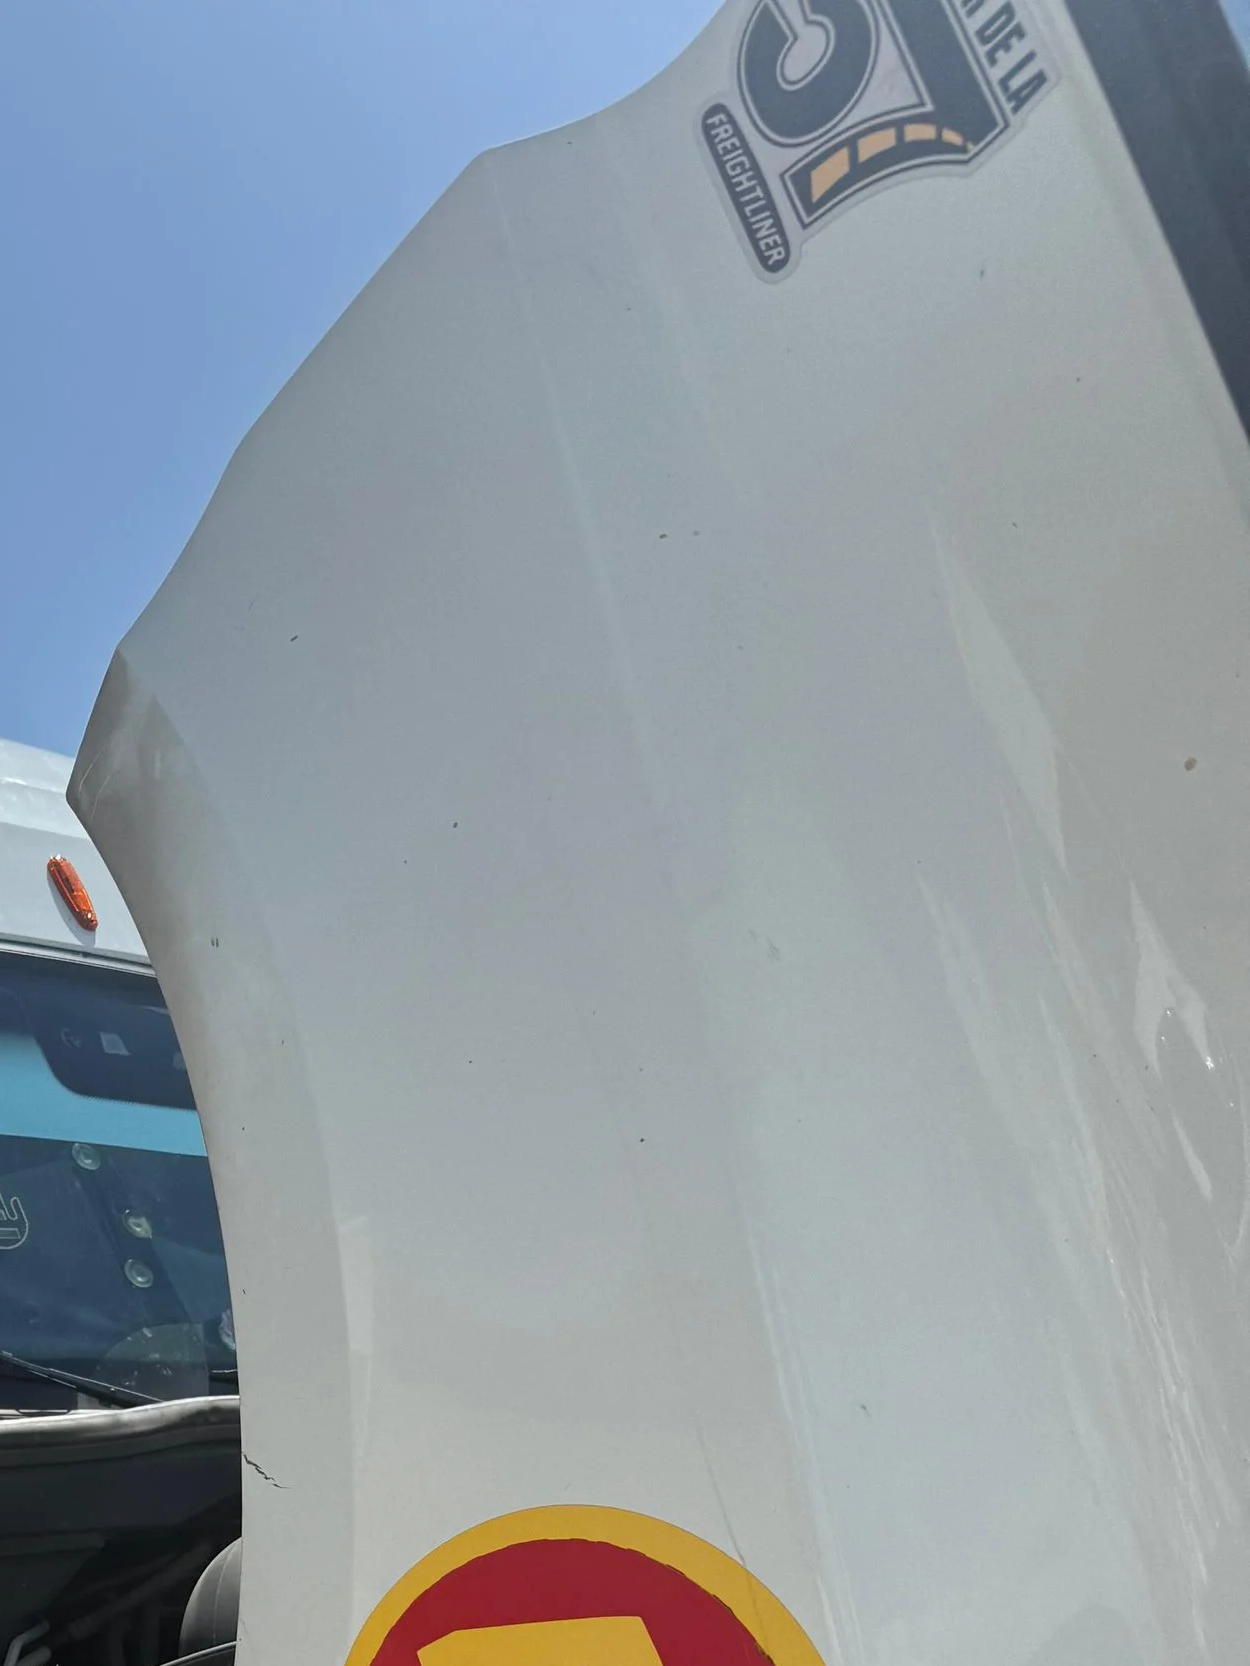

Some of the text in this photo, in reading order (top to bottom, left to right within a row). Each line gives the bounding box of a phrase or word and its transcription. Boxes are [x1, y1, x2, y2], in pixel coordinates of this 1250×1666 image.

[975, 1, 1048, 115] DE LA
[704, 111, 786, 267] FREIGHTLINER
